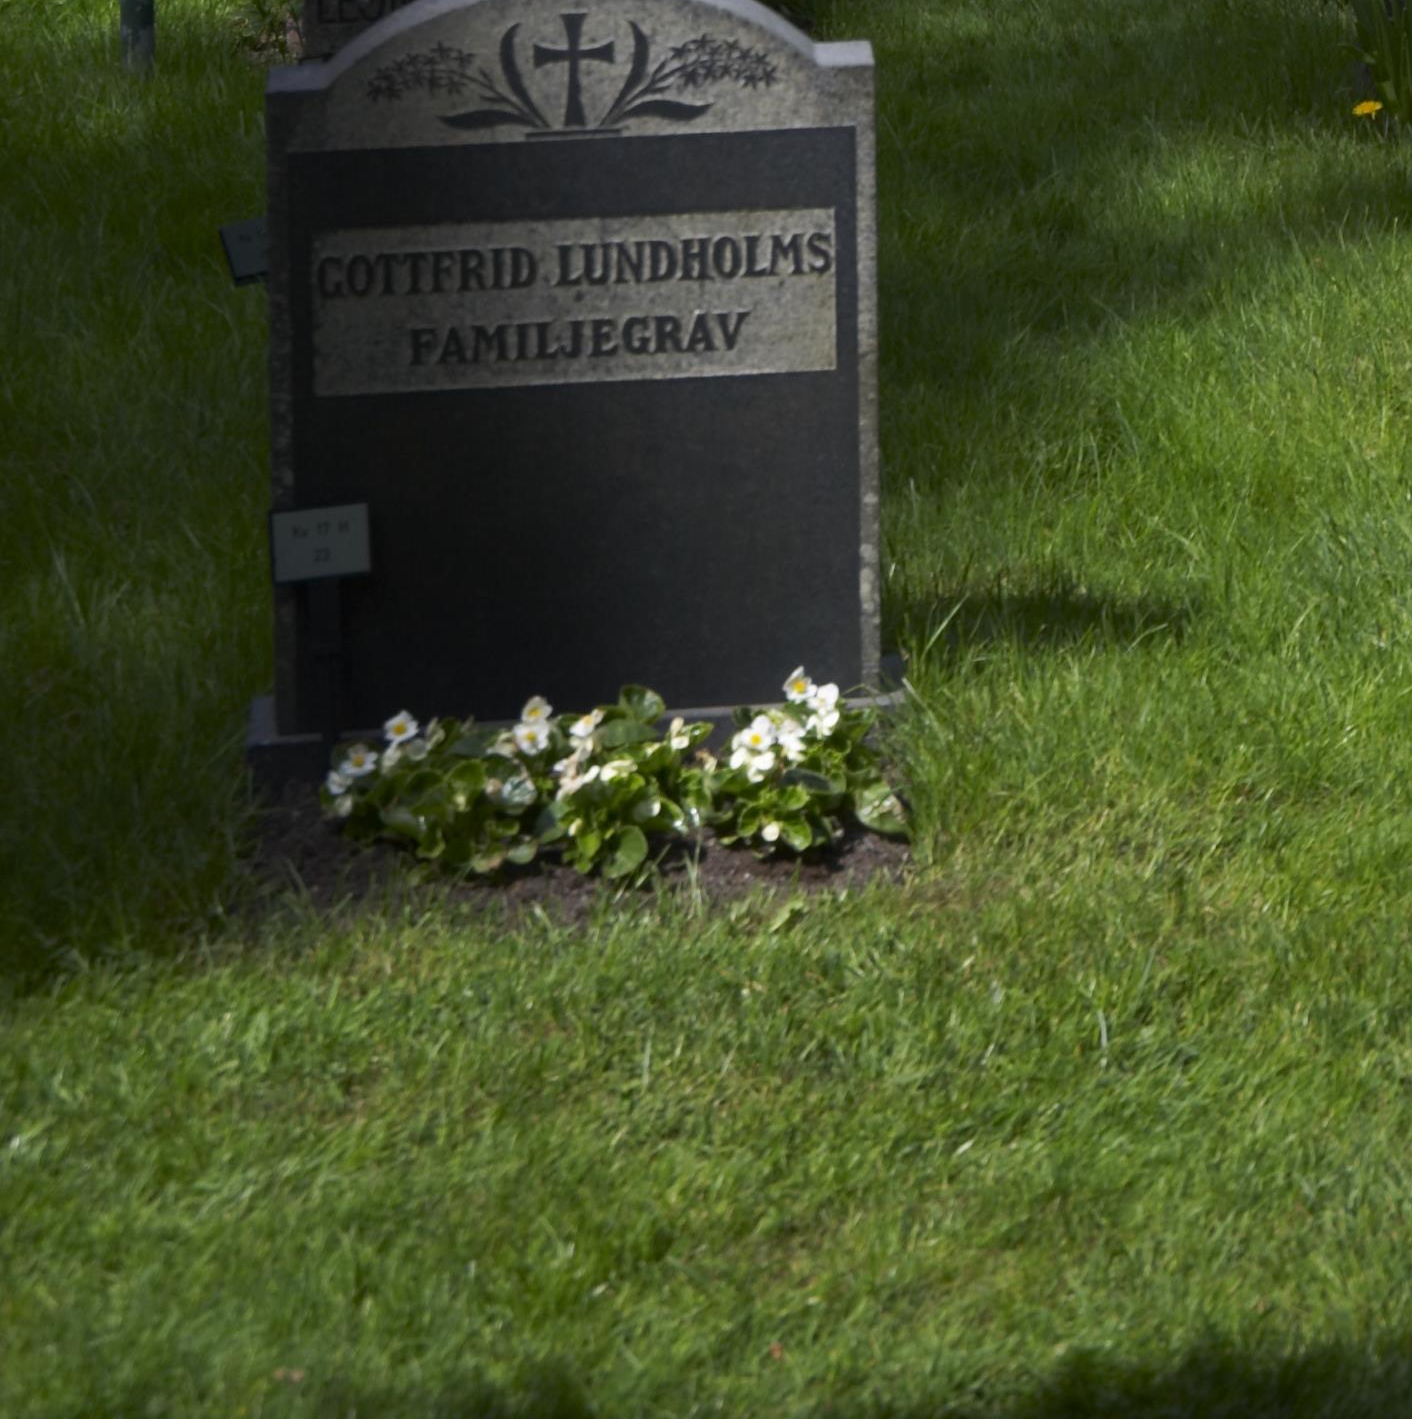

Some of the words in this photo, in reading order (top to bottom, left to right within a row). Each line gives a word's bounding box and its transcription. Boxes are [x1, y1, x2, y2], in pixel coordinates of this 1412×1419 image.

[318, 246, 537, 299] GOTTFRID
[556, 231, 833, 287] LUNDHOLMS
[410, 310, 750, 365] FAMILJEGRAV
